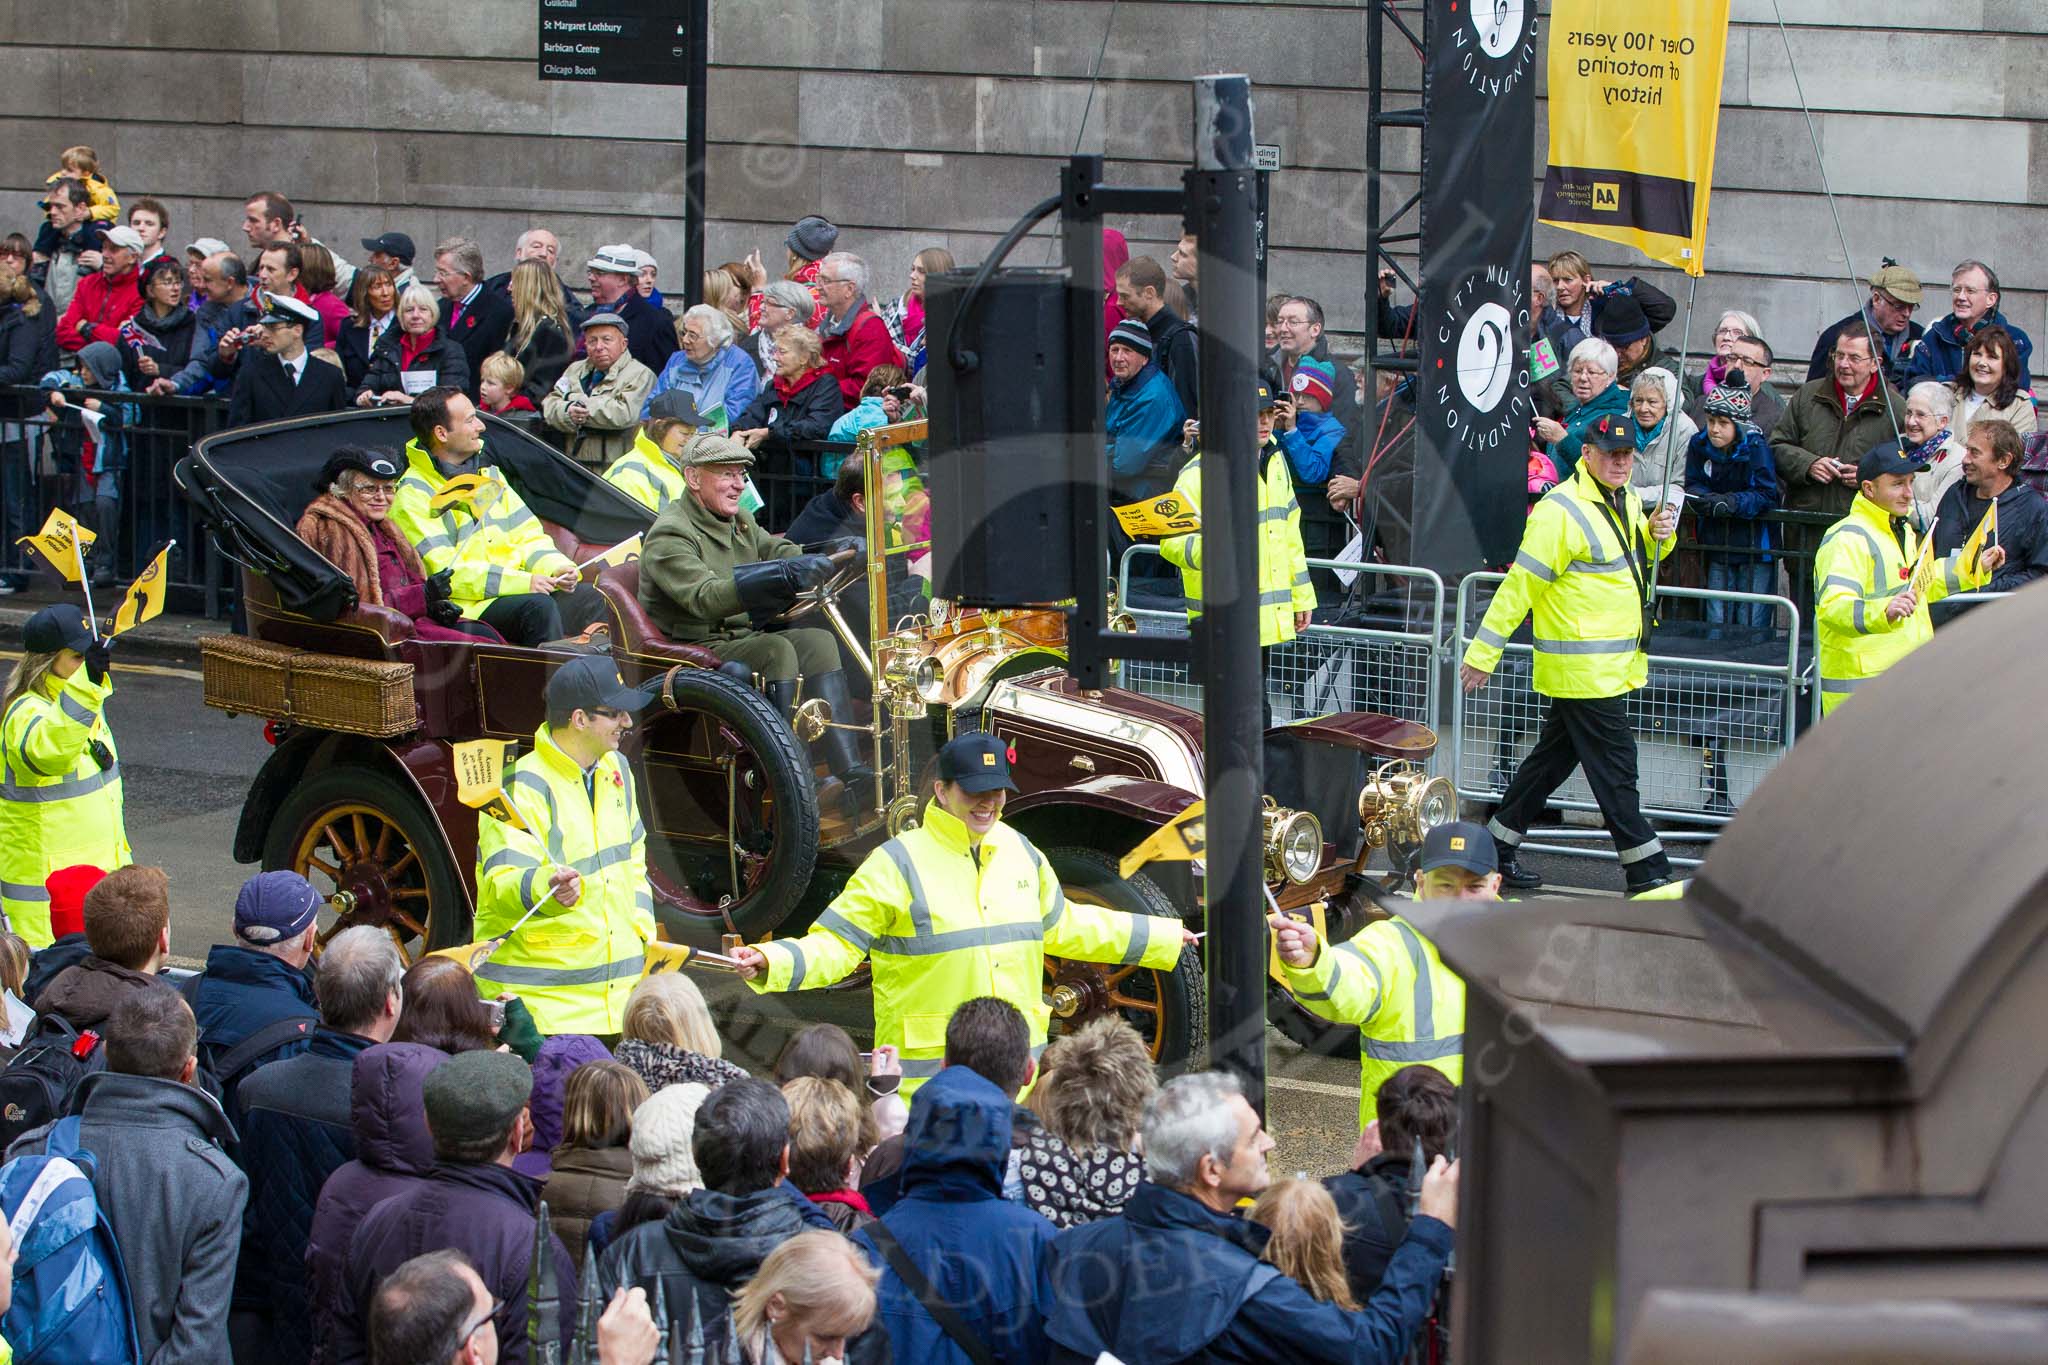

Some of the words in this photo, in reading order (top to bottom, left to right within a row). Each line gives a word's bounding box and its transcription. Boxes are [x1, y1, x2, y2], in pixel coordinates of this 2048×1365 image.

[544, 0, 577, 8] Guildhall
[544, 20, 553, 30] St
[554, 21, 586, 32] Margaret
[588, 22, 622, 33] Lothbury
[544, 43, 574, 53] Barbican
[575, 44, 601, 54] Centre
[544, 64, 573, 75] Chicago
[575, 65, 597, 75] Booth
[1259, 158, 1276, 167] time
[1485, 264, 1530, 328] MUSIC
[1439, 276, 1475, 344] CITY
[1438, 348, 1531, 452] FOUNDATION
[1017, 880, 1029, 889] AA
